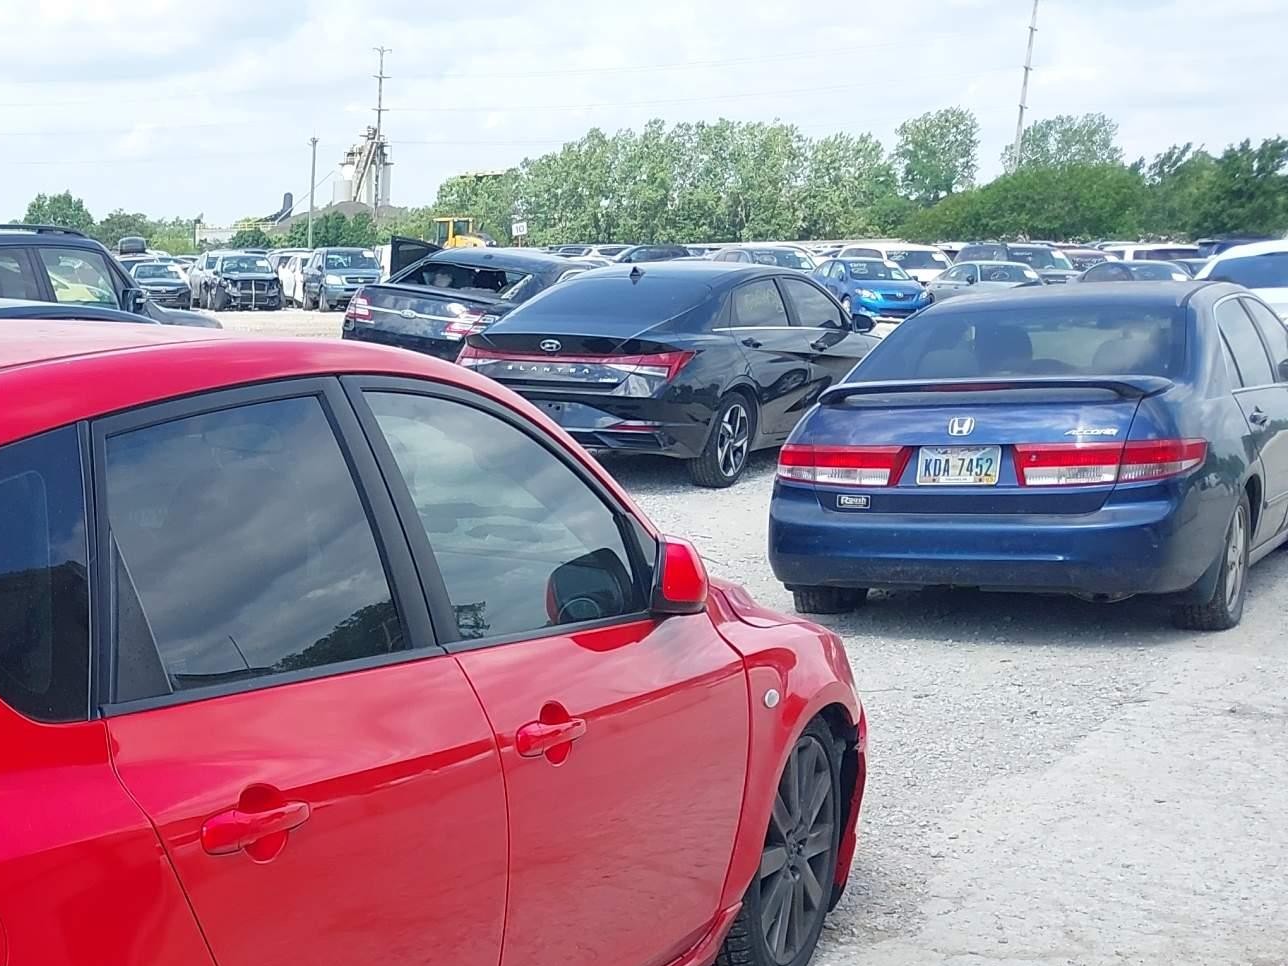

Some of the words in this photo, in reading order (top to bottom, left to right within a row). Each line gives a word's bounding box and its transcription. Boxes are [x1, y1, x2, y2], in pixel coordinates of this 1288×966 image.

[507, 365, 590, 374] ELANTRA
[924, 458, 950, 477] KDA
[957, 457, 993, 477] 7452
